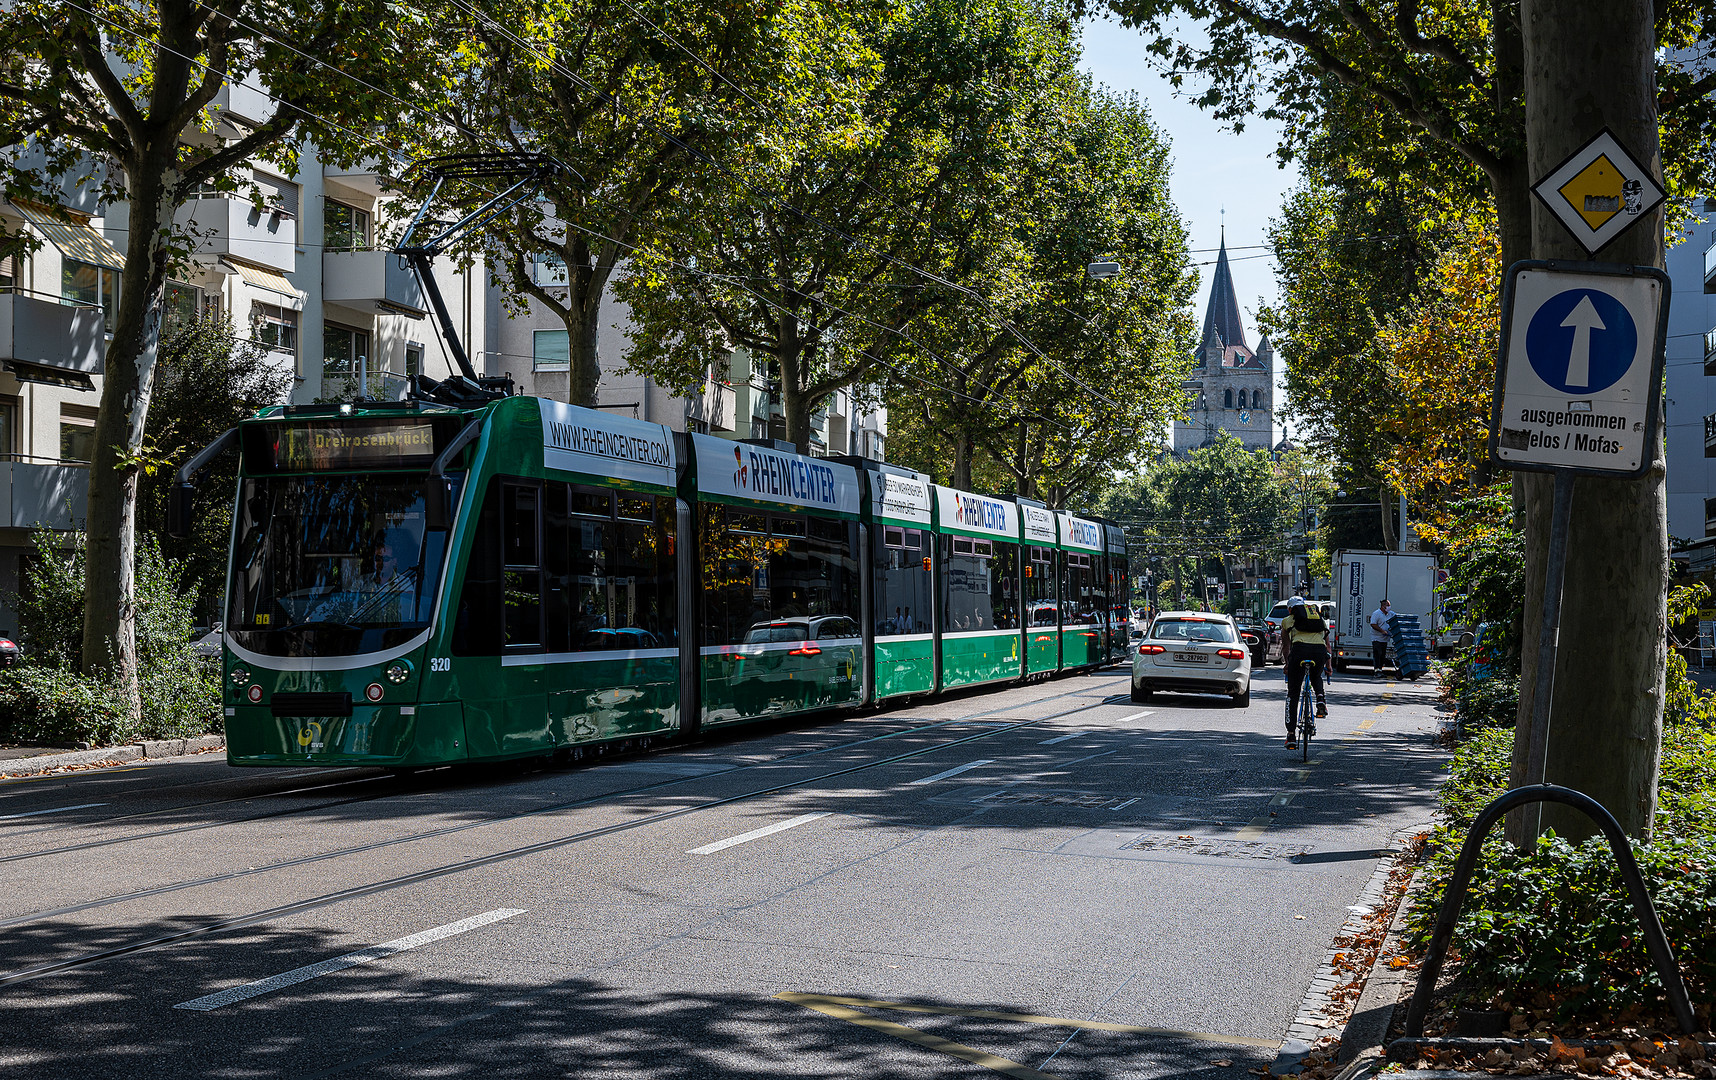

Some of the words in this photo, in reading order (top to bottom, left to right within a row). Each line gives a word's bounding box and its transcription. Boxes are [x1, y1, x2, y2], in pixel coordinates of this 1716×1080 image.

[1521, 408, 1627, 430] ausgenommen
[315, 430, 433, 448] Dreirosenbrück
[549, 420, 671, 466] WWW.RHEINCENTER.COM
[1574, 433, 1620, 454] Mofas
[749, 451, 836, 504] RHEINCENTER
[962, 496, 1007, 532] RHEINCENTER
[430, 657, 450, 672] 320
